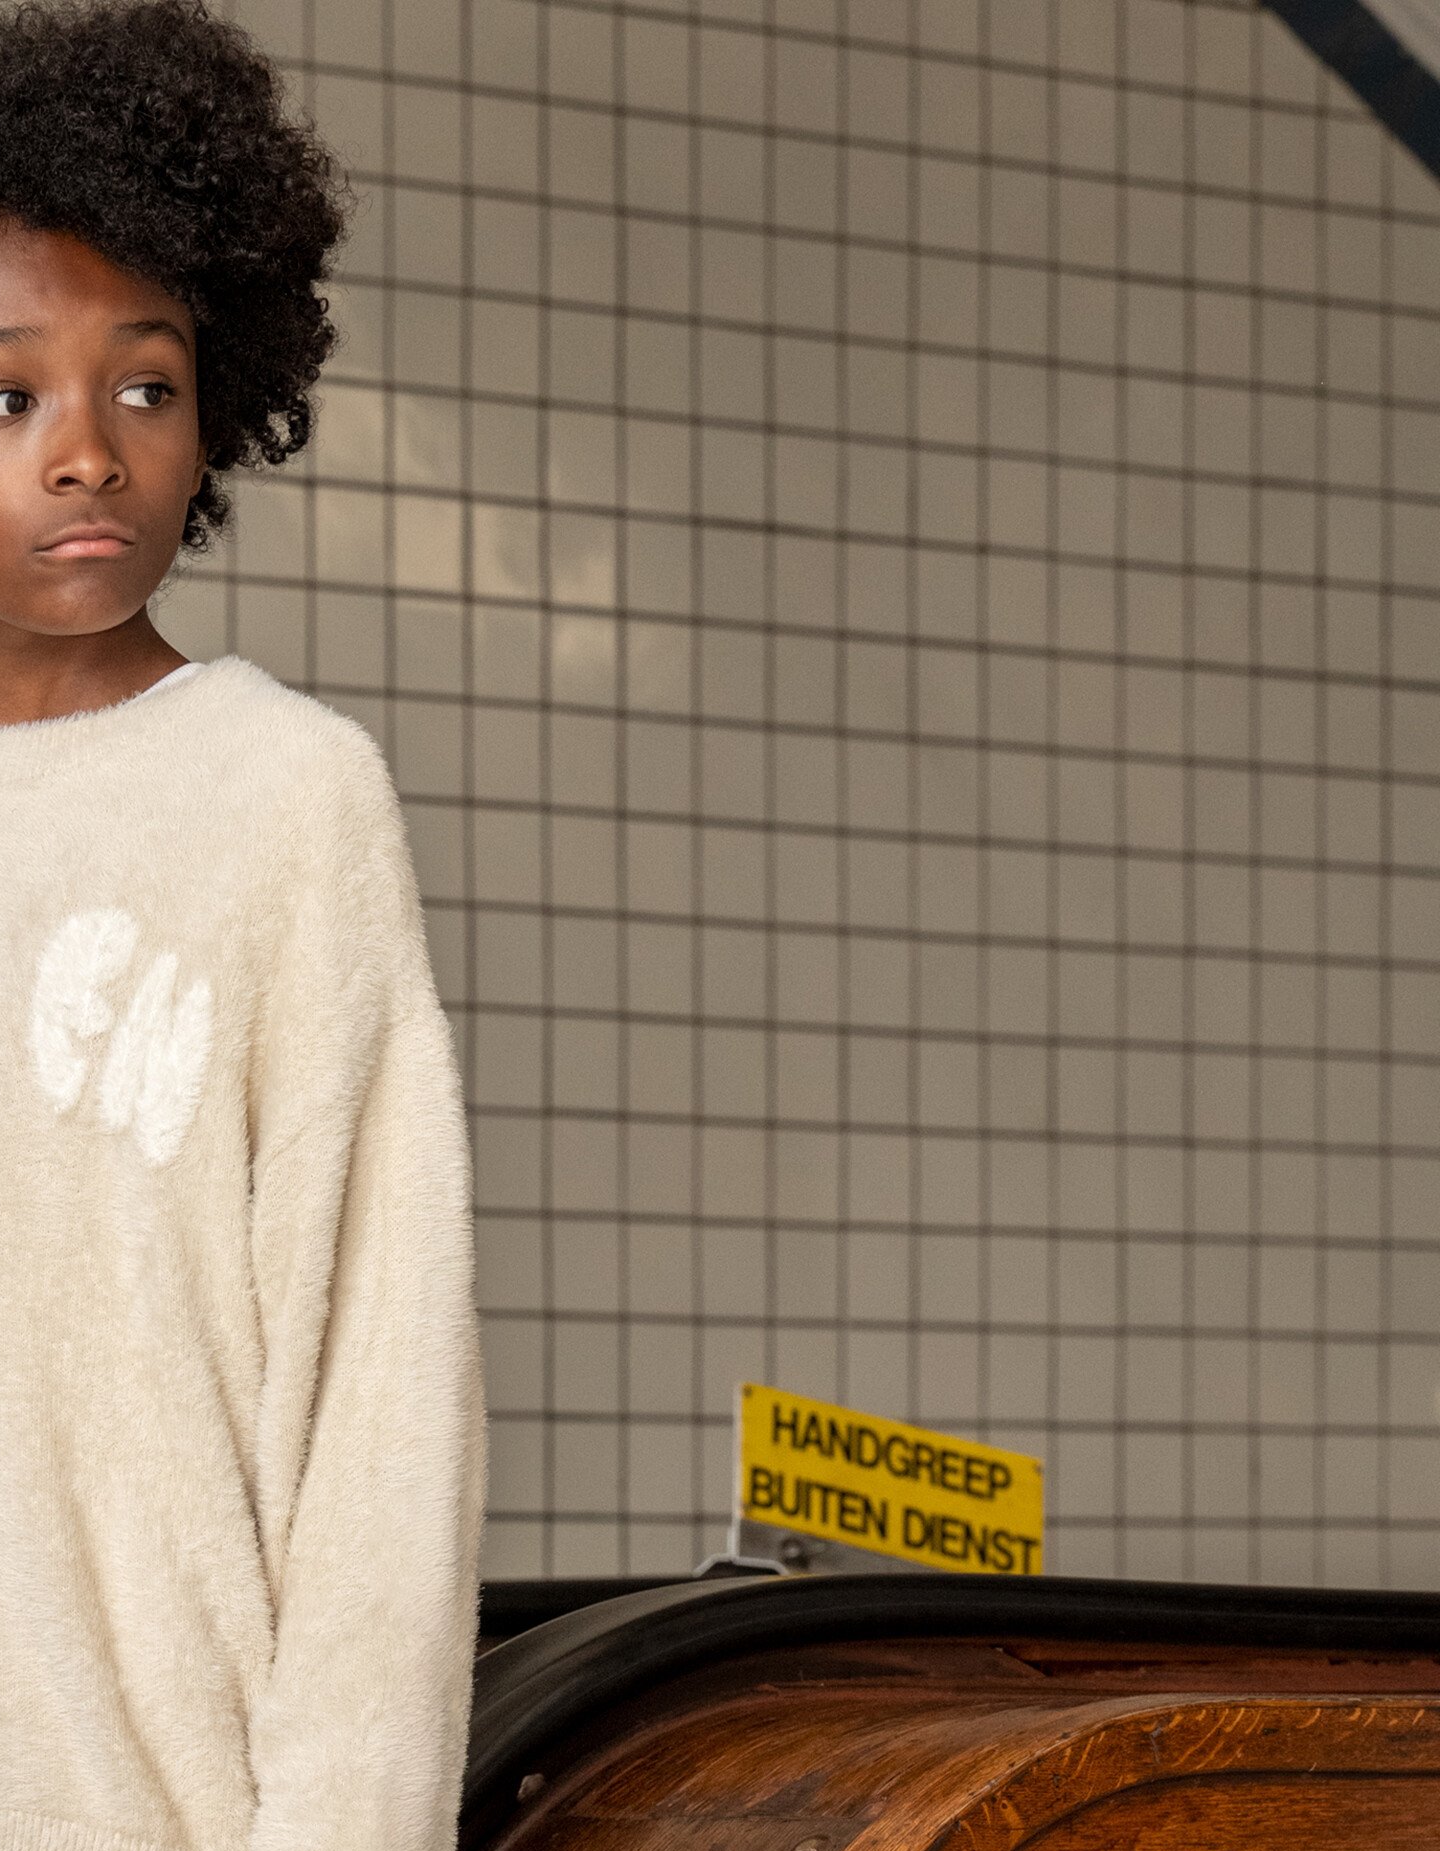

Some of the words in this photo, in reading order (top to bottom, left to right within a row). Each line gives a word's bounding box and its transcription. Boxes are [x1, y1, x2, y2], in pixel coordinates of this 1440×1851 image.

[772, 1403, 1012, 1501] HANDGREEP
[749, 1466, 889, 1541] BUITEN
[902, 1506, 1040, 1575] DIENST
